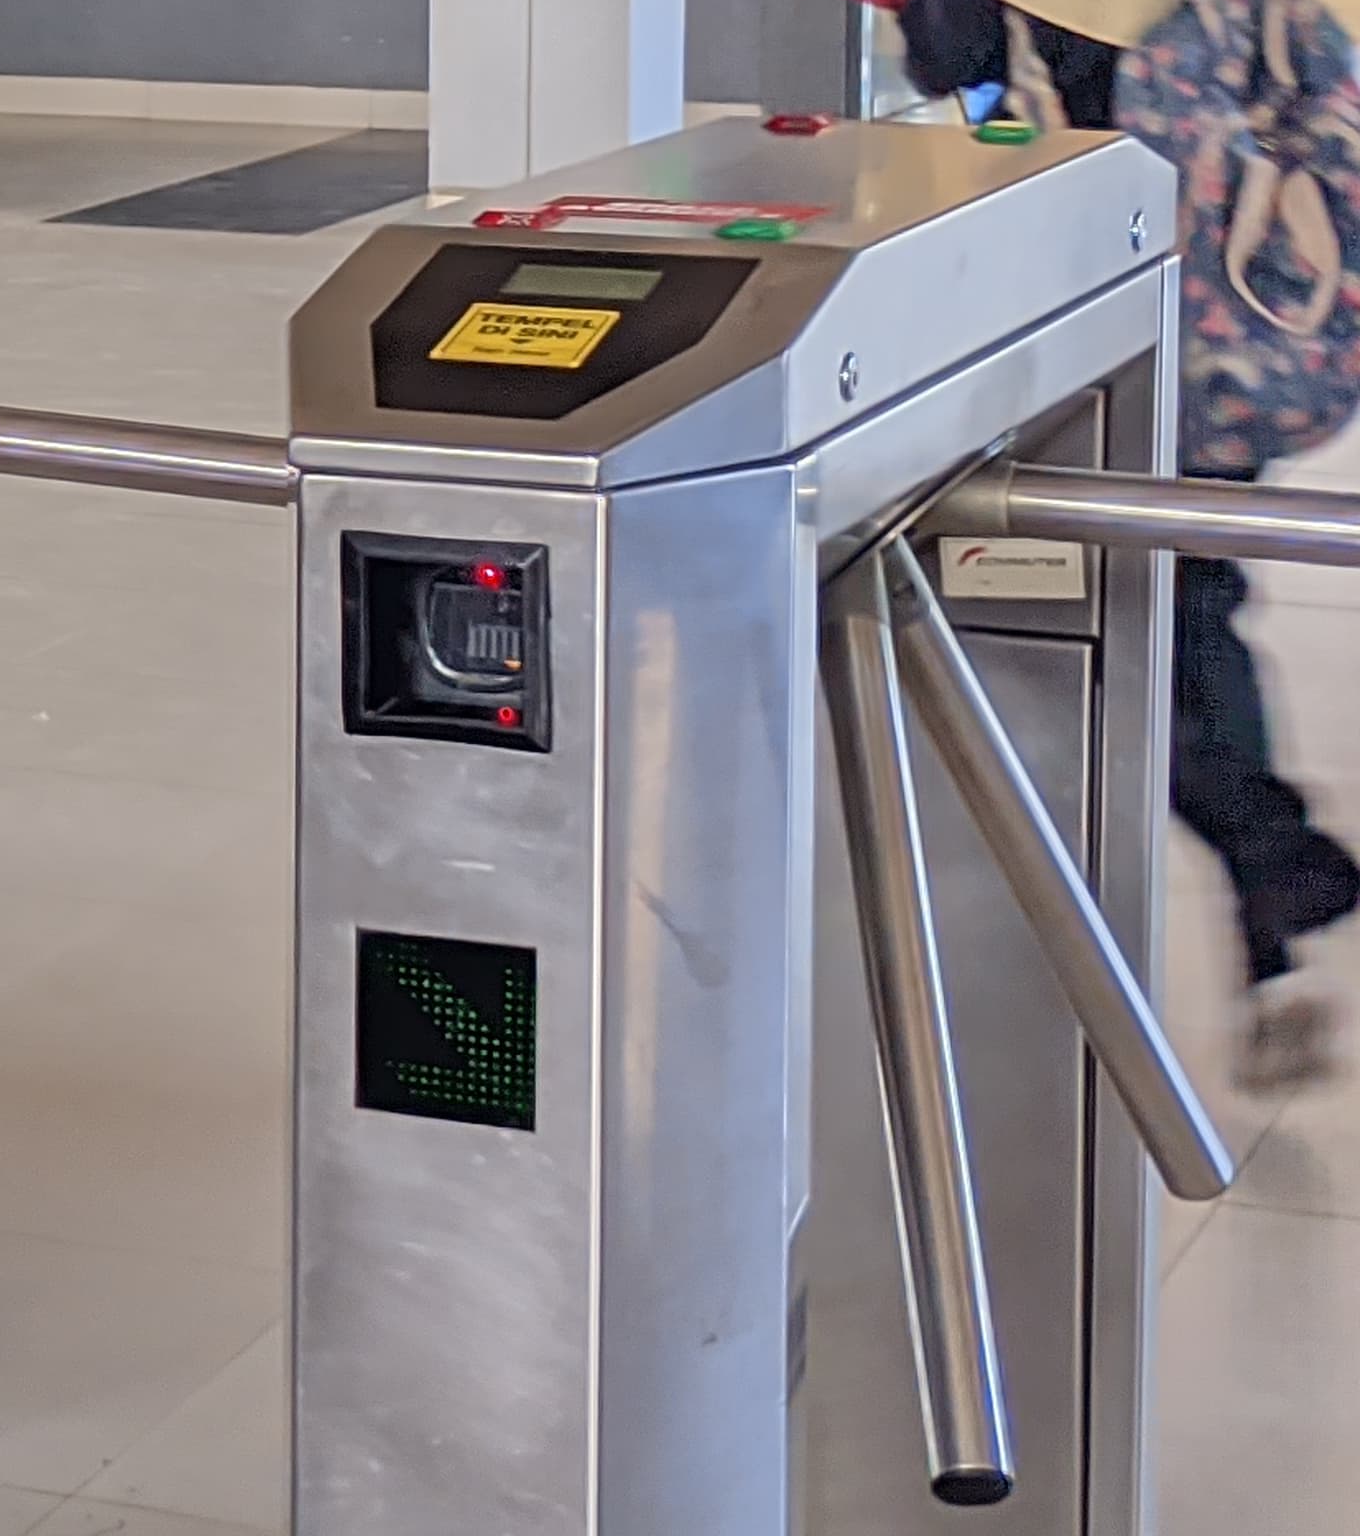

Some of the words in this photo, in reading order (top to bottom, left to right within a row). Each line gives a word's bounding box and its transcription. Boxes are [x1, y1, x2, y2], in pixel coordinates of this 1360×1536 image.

[481, 312, 596, 330] TEMPEL
[478, 324, 510, 336] DI
[515, 326, 579, 340] SINI
